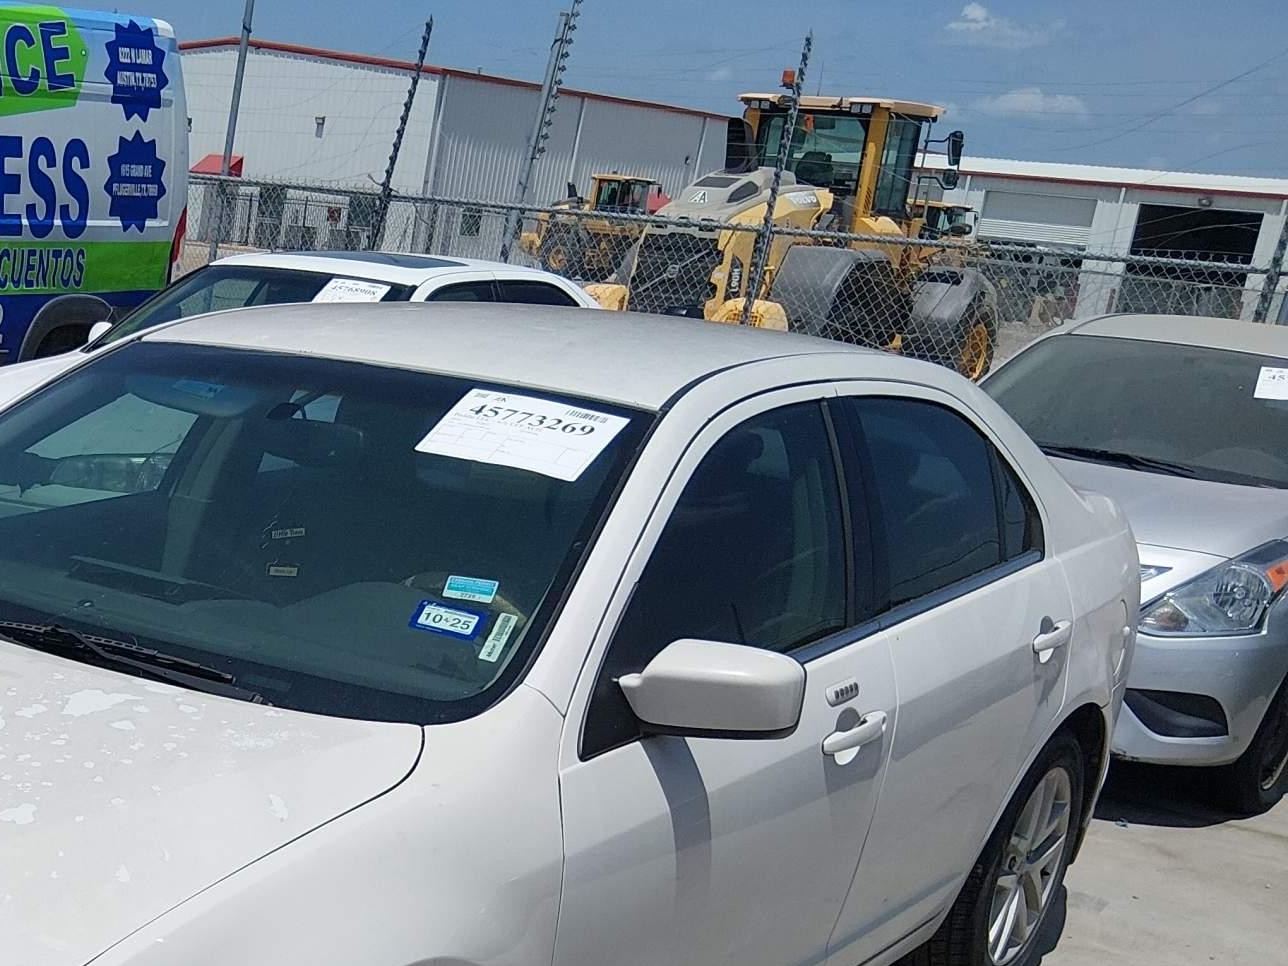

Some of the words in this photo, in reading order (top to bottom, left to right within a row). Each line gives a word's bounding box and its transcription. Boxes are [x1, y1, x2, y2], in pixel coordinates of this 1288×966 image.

[469, 403, 596, 436] 45773269
[424, 612, 444, 624] 10
[449, 618, 473, 630] 25
